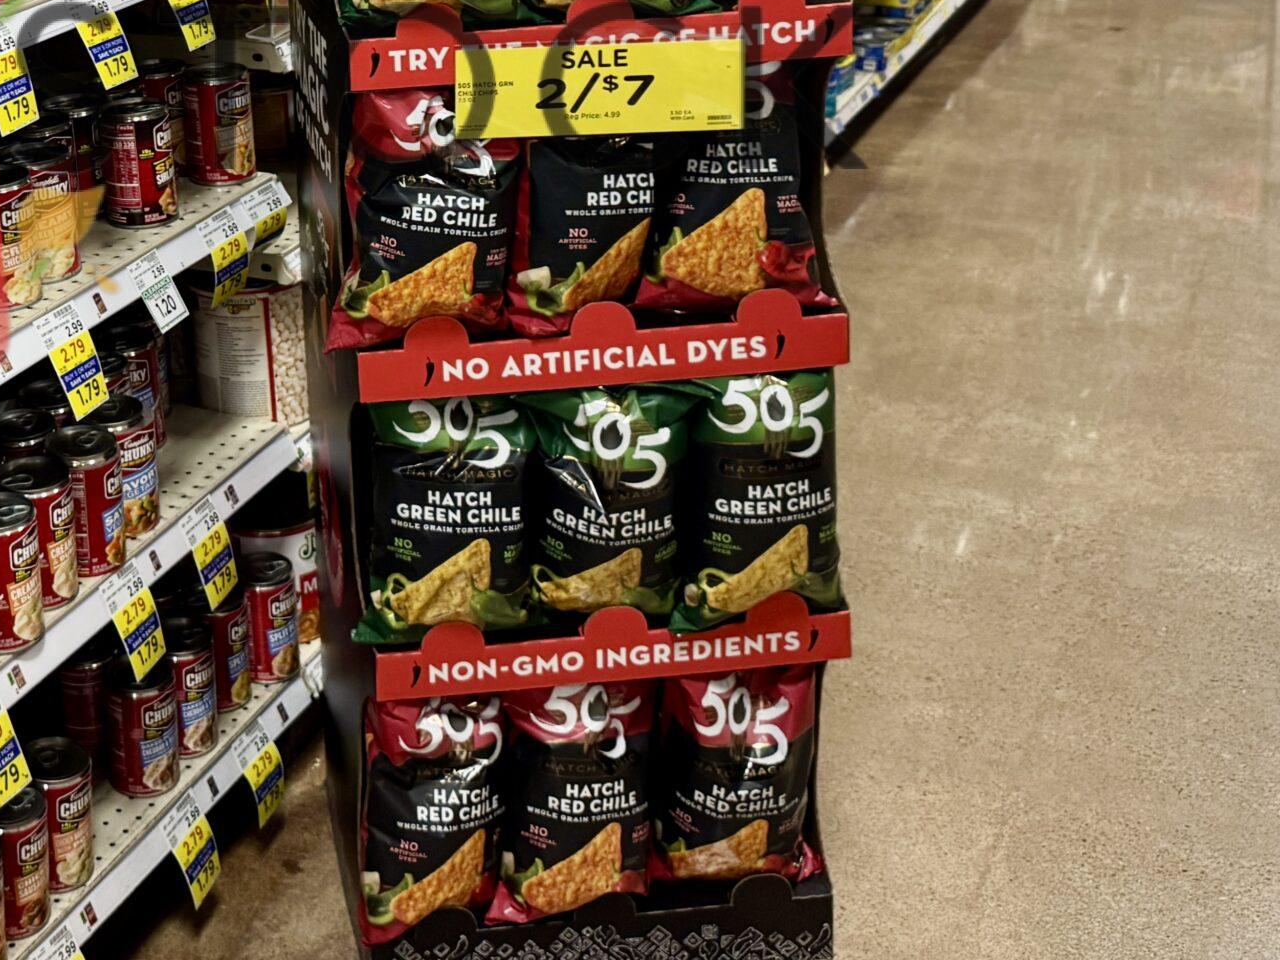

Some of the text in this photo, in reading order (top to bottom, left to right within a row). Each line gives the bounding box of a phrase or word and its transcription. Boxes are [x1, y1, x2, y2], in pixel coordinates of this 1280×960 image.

[188, 20, 211, 42] 1.79
[388, 48, 450, 74] TRY
[713, 19, 816, 46] HATCH
[561, 49, 629, 70] SALE
[474, 81, 496, 89] HATCH
[480, 89, 498, 97] CHIPS
[582, 111, 602, 120] Price:
[603, 110, 621, 119] 4.99
[417, 194, 485, 211] HATCH
[442, 210, 497, 229] CHILE
[154, 296, 177, 321] 1.20
[442, 336, 768, 382] NO ARTIFICIAL DYES
[707, 378, 829, 459] 505
[427, 490, 492, 507] HATCH
[396, 504, 521, 524] GREEN CHILE
[428, 631, 801, 685] NON-GMO INGREDIENTS
[693, 675, 790, 764] 505
[565, 780, 625, 797] HATCH
[547, 790, 637, 814] RED CHILE
